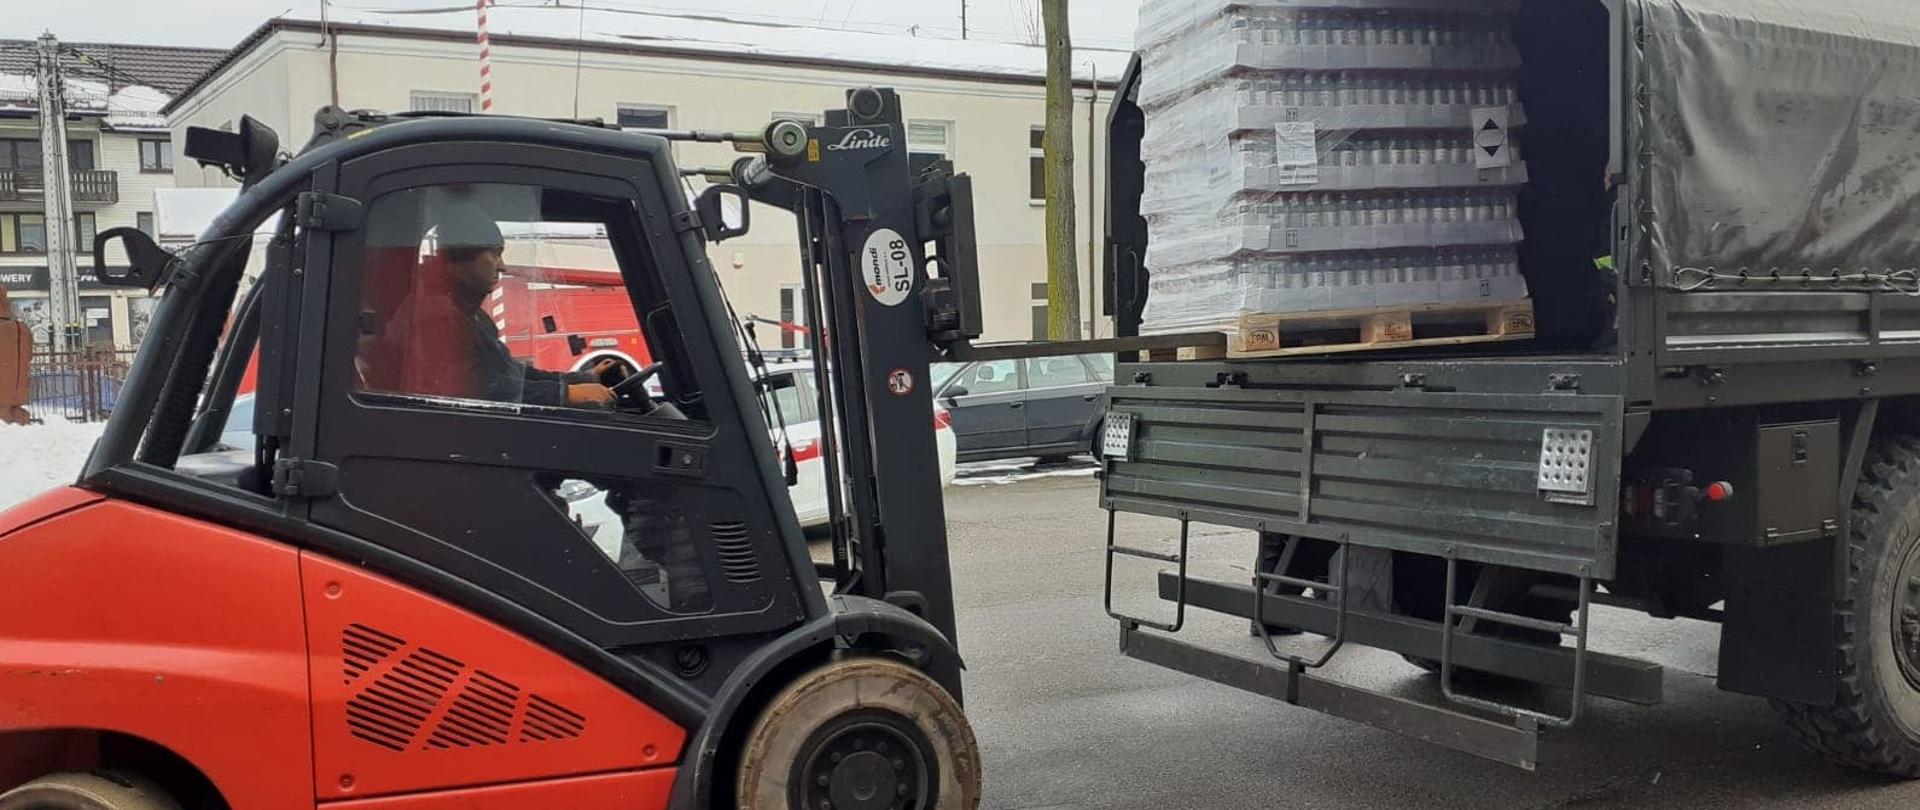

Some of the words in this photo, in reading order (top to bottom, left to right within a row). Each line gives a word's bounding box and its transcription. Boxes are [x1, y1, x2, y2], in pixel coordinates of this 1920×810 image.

[827, 128, 890, 150] Linde
[869, 247, 882, 286] mondi
[889, 239, 910, 292] SL-08
